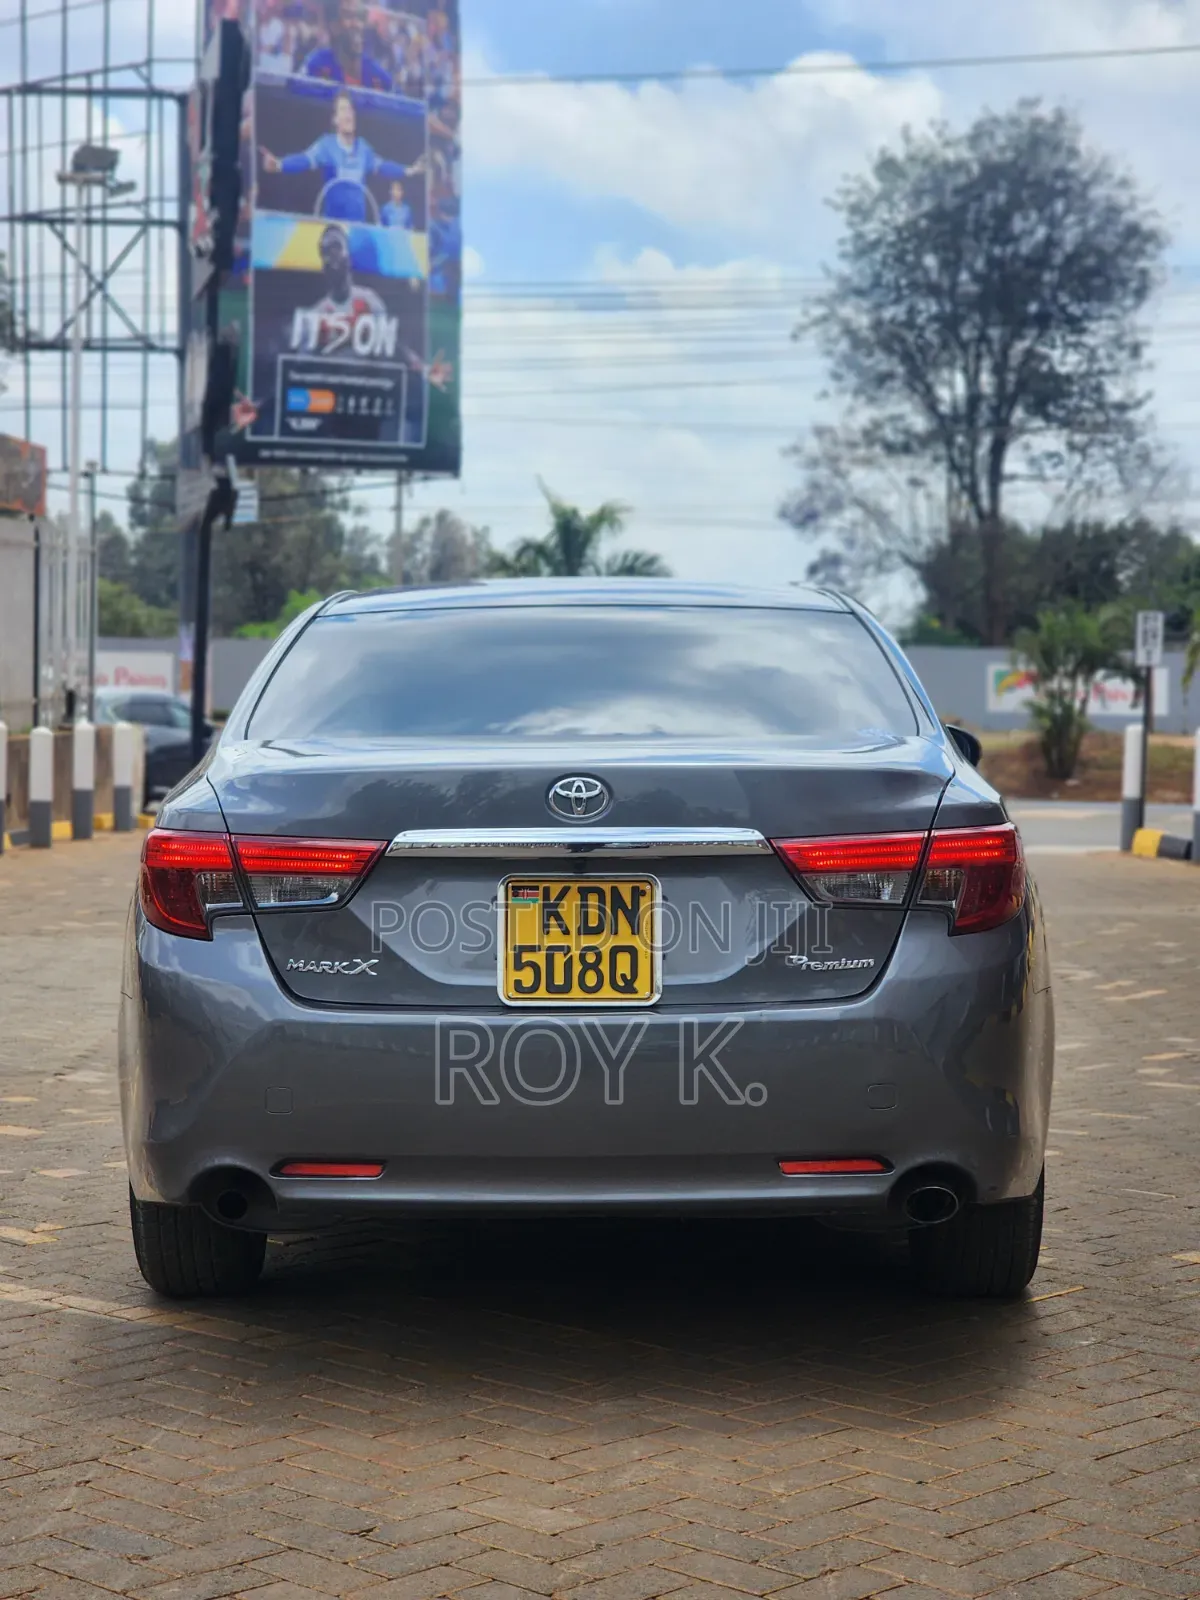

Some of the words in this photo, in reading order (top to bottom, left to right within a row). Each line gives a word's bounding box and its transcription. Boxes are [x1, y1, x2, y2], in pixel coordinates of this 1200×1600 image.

[542, 885, 640, 936] KDN
[513, 944, 639, 994] 508Q
[787, 955, 875, 971] Premium
